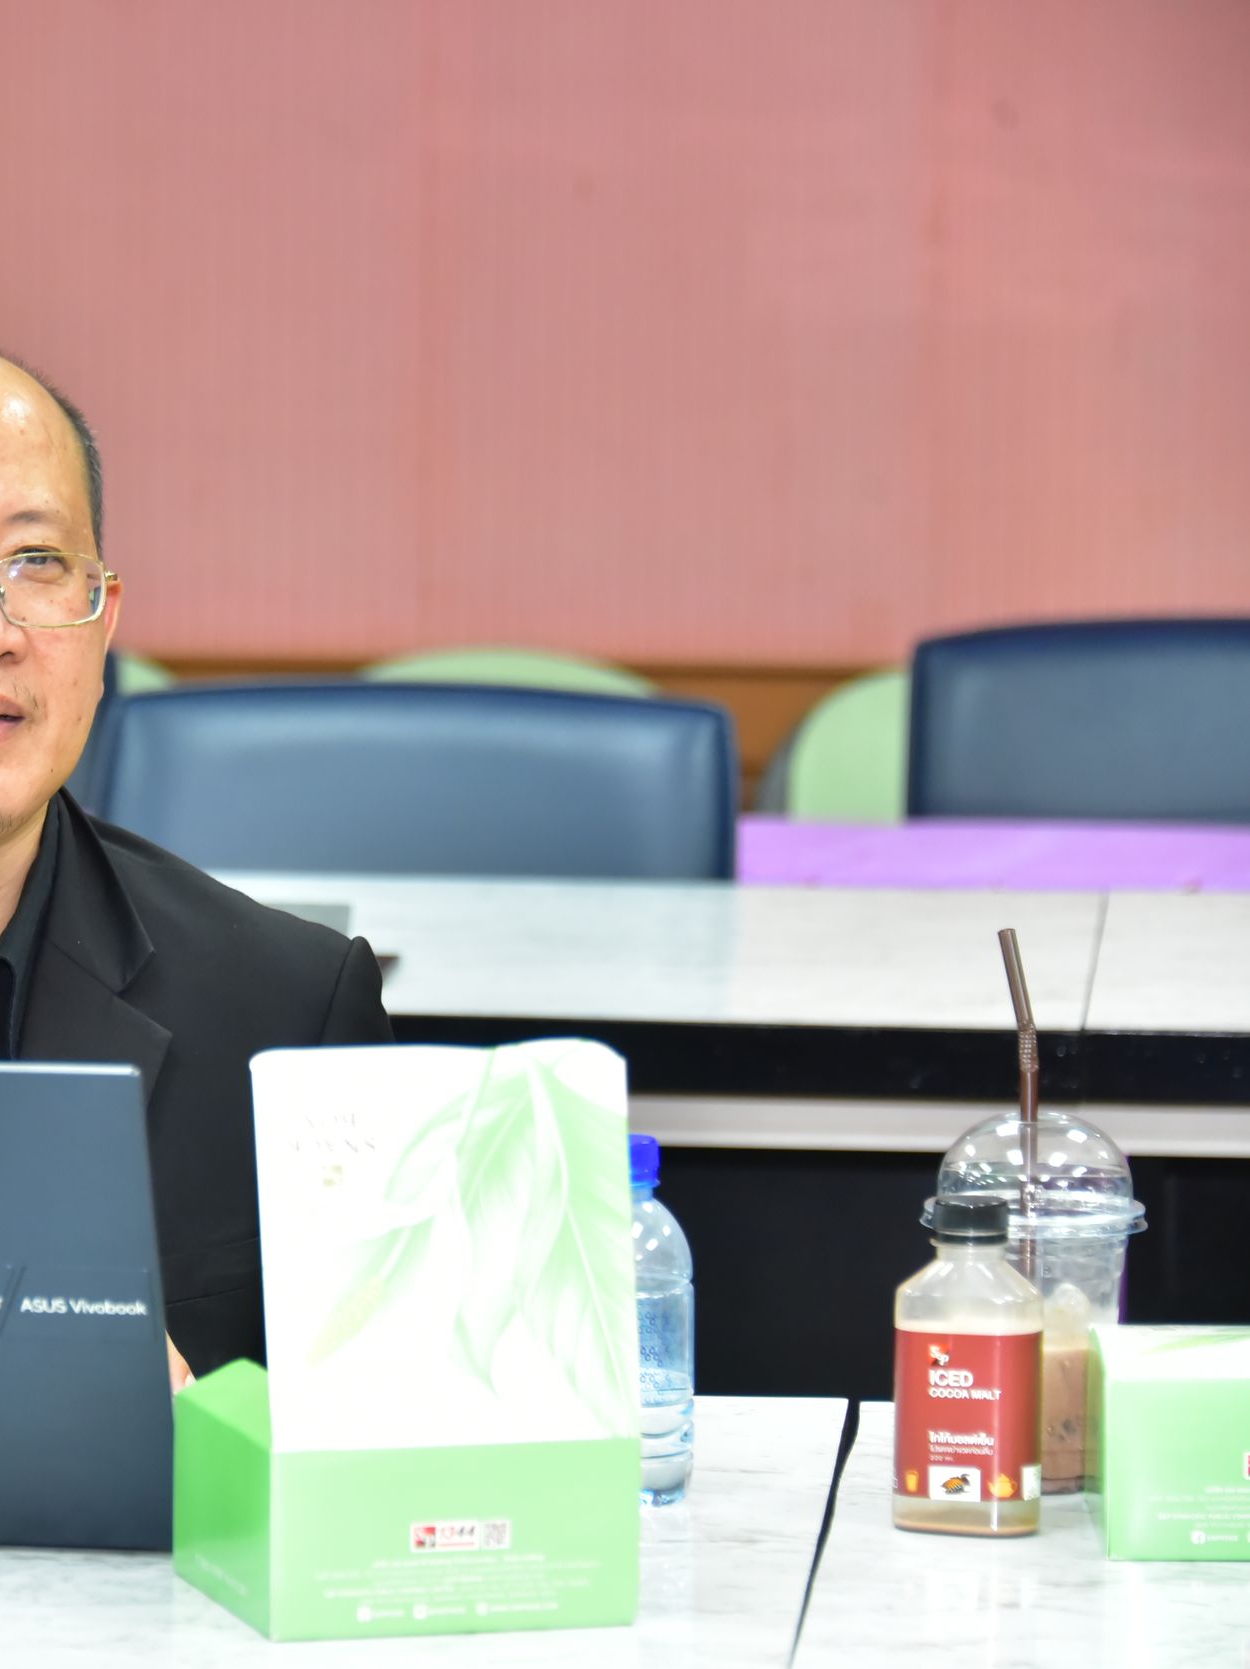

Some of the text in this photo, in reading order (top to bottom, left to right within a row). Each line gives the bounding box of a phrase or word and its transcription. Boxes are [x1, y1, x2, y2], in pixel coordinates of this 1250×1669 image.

[20, 1297, 148, 1315] ASUS Vivobook
[929, 1370, 974, 1387] ICED
[929, 1387, 1001, 1401] COCOA MALT
